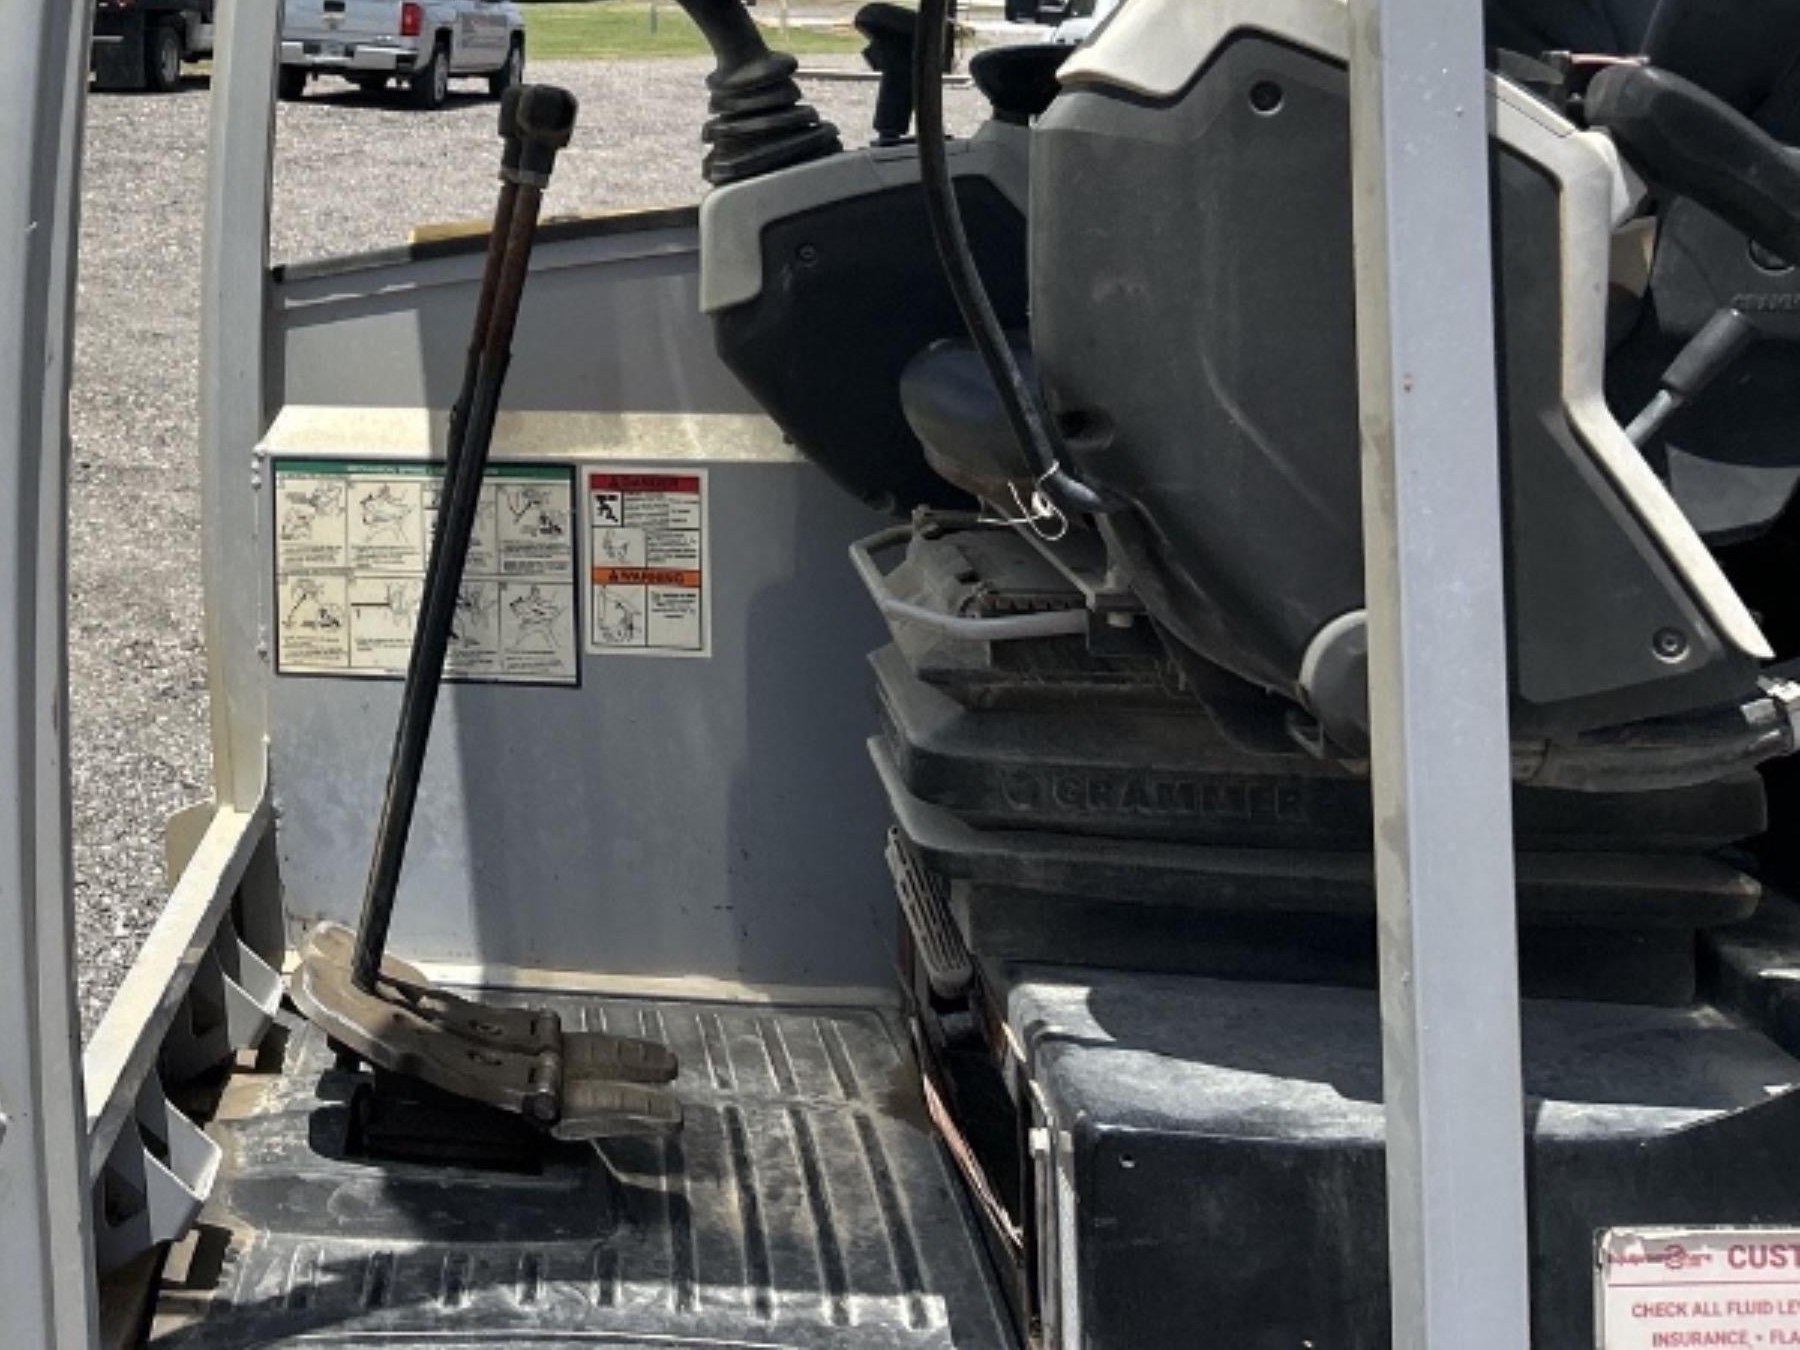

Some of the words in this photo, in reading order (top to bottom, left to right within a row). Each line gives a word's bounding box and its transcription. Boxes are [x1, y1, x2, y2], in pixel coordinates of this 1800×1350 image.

[1632, 1302, 1688, 1318] CHECK
[1692, 1301, 1722, 1317] ALL
[1727, 1300, 1773, 1316] FLUID
[1652, 1329, 1748, 1348] INSURANCE
